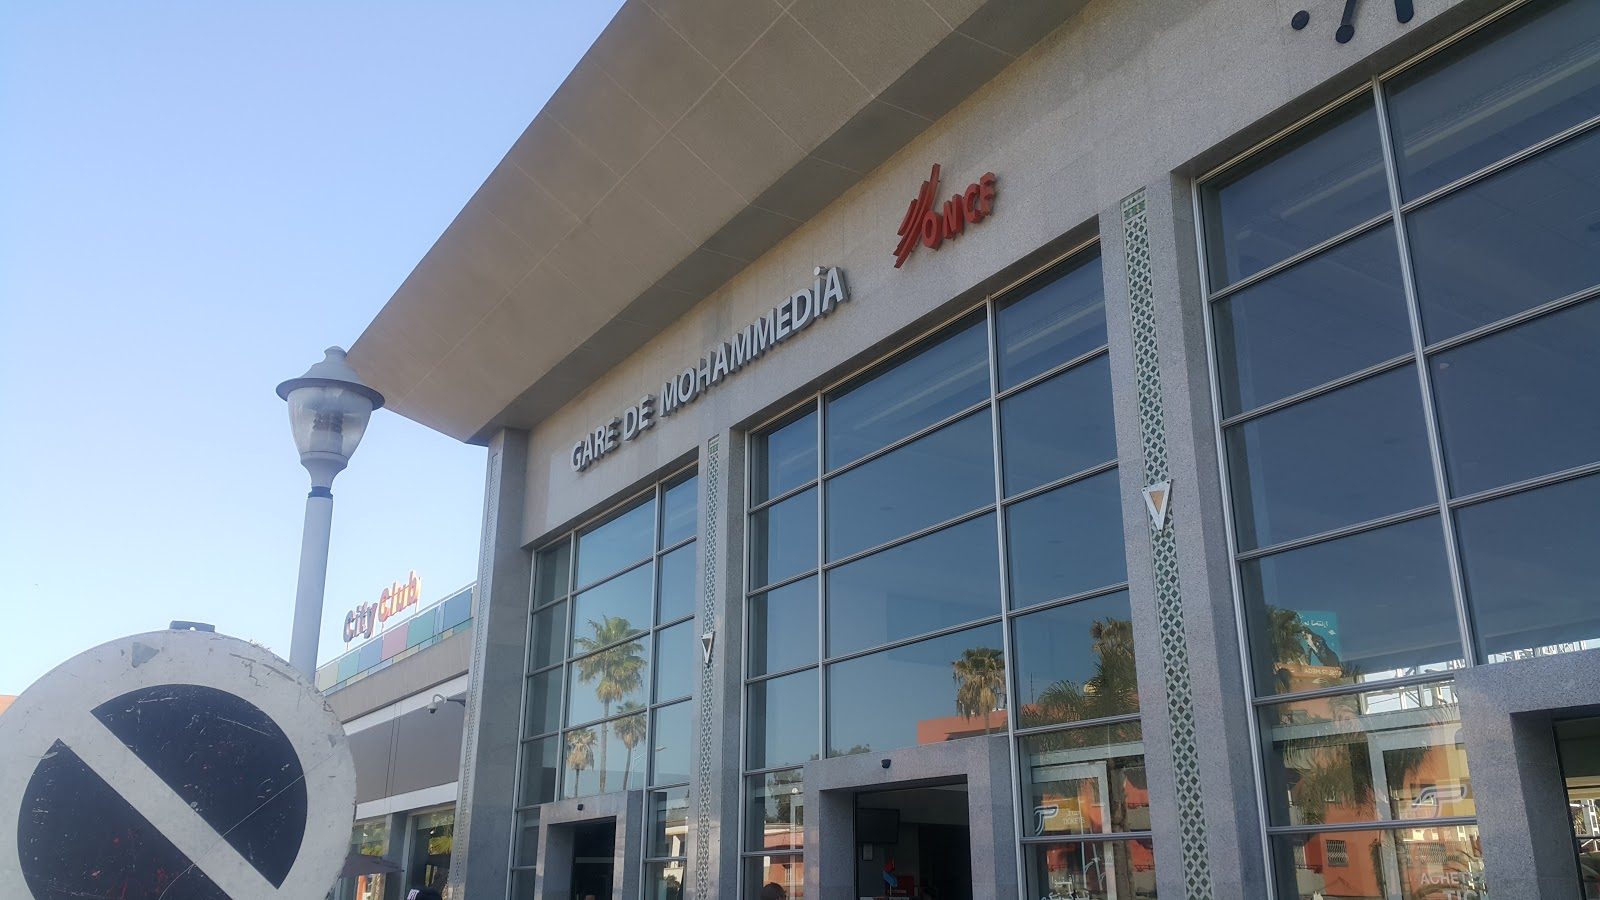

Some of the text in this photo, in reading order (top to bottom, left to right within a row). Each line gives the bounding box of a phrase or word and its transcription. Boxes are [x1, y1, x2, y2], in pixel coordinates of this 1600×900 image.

[922, 171, 996, 251] ONCF
[570, 417, 621, 472] GARE
[623, 394, 654, 442] DE
[343, 570, 420, 643] City Club
